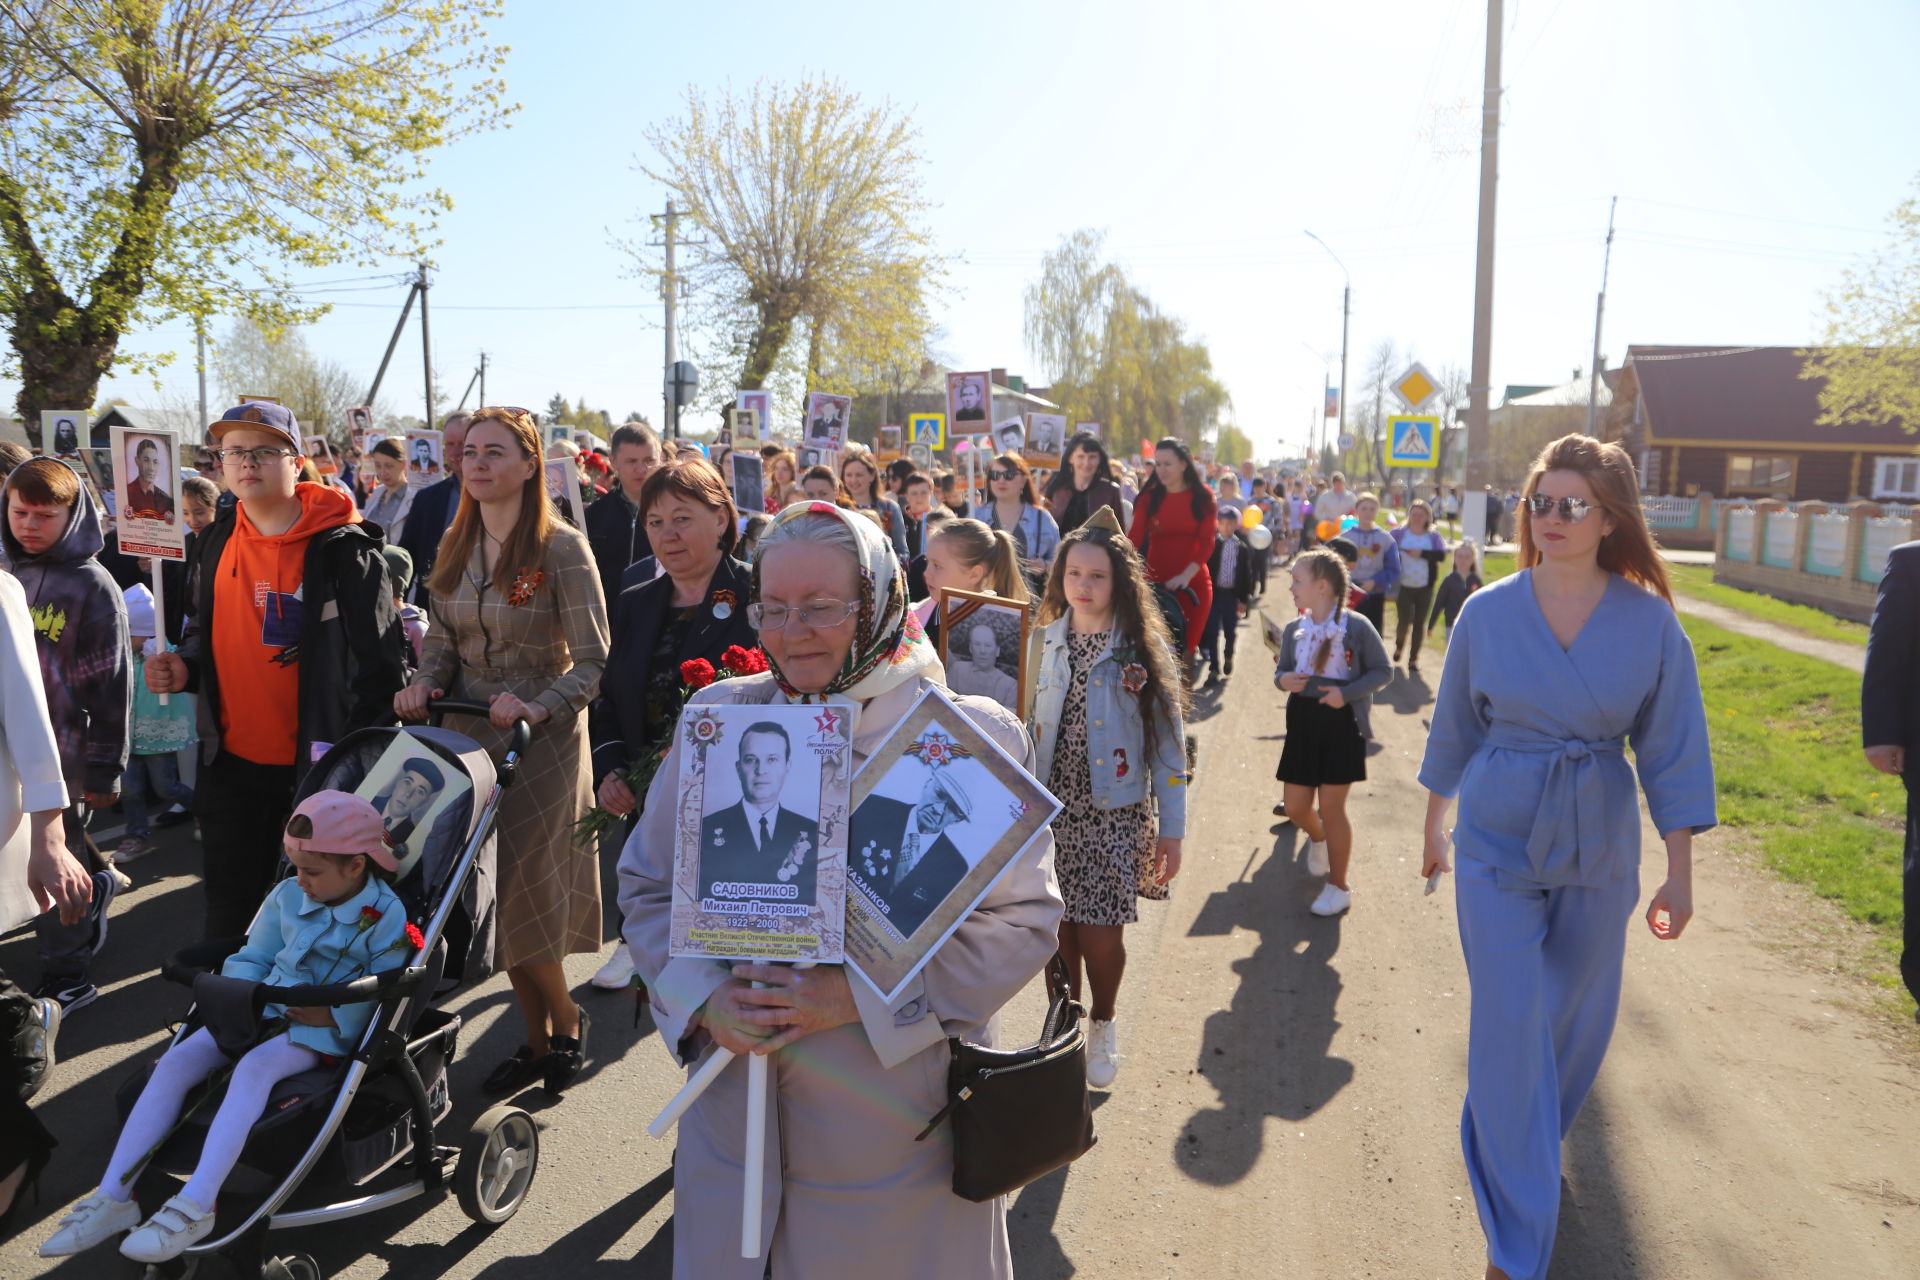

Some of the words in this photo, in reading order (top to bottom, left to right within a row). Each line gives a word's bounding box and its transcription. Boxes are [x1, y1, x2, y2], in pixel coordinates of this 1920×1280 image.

[712, 883, 798, 898] САДОВНИКОВ
[703, 900, 748, 912] Михаил
[750, 901, 808, 916] Петрович
[727, 918, 748, 928] 1922
[756, 918, 779, 929] 2000
[852, 889, 904, 945] Гаврилович
[690, 930, 719, 940] Участник
[719, 931, 746, 940] Великой
[747, 933, 795, 943] Отечественной
[795, 935, 817, 944] войны
